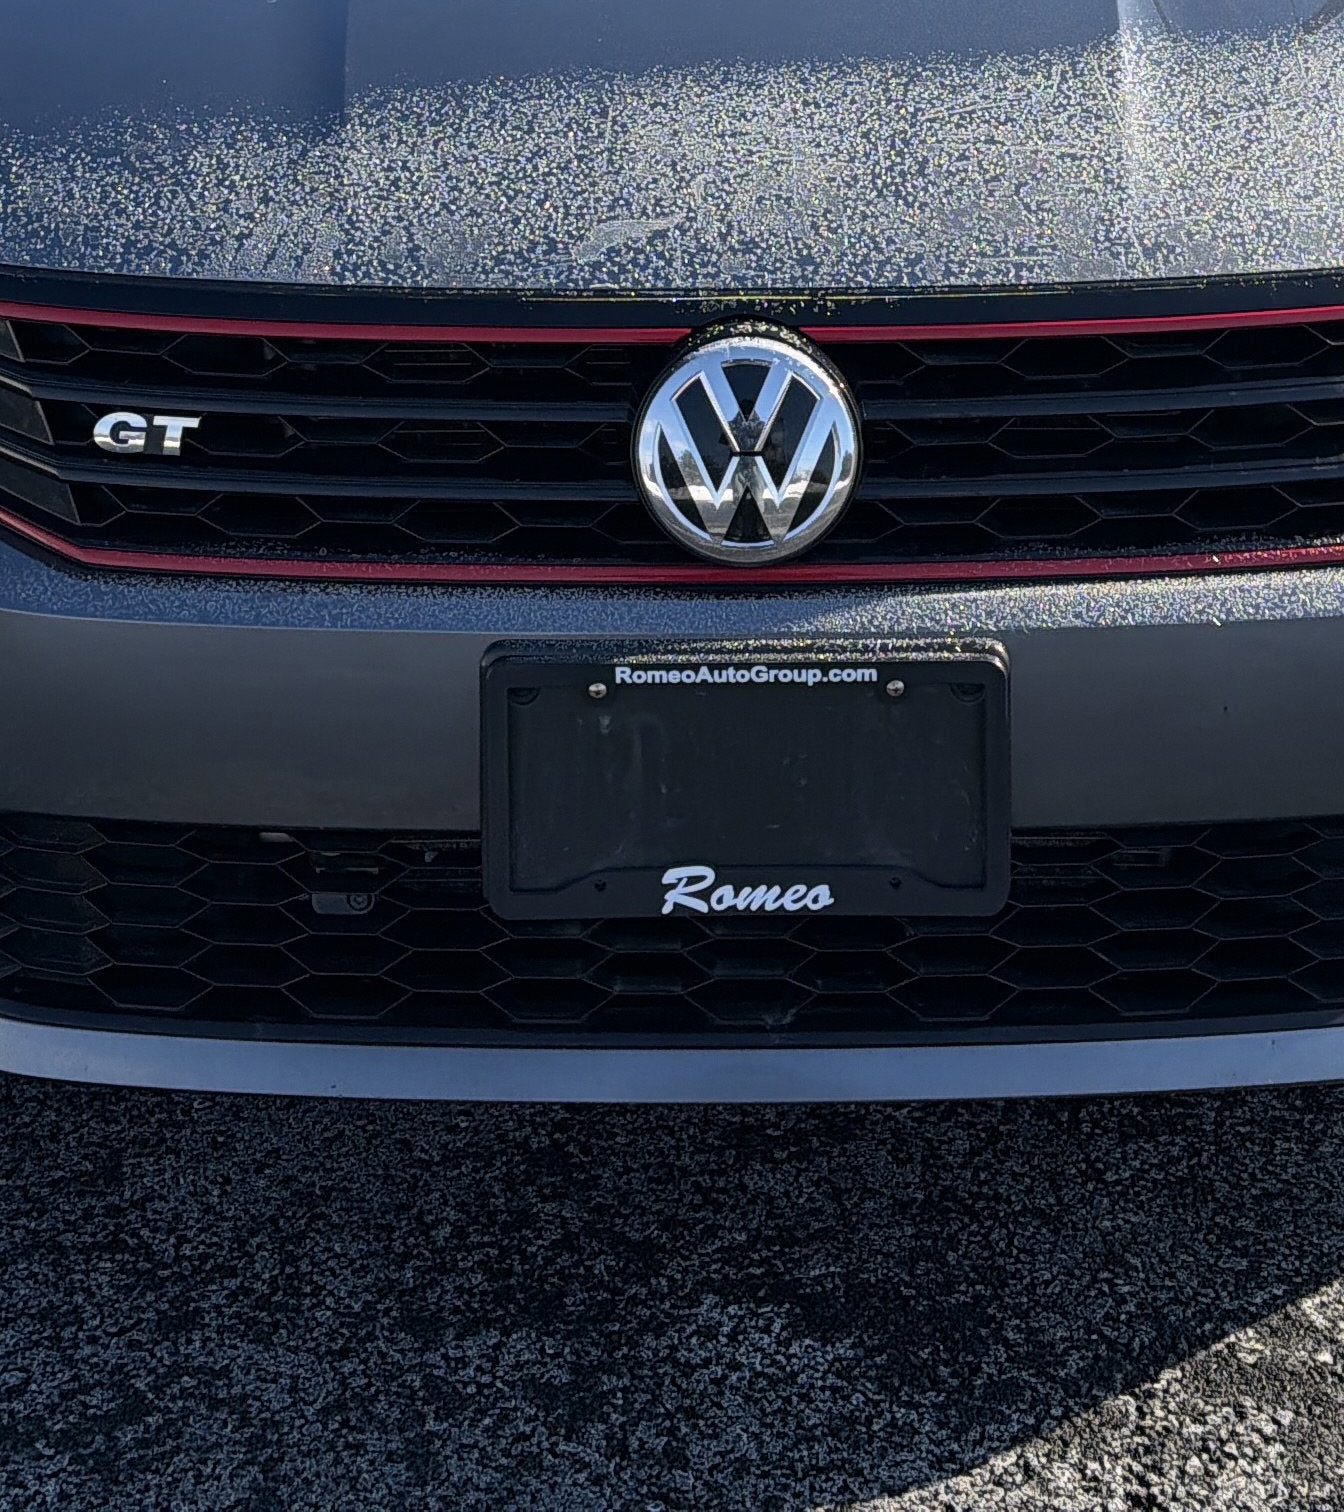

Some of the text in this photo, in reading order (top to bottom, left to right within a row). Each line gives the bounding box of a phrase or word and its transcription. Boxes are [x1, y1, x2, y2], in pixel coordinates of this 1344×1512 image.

[93, 411, 202, 457] GT
[642, 341, 853, 557] VW
[615, 665, 878, 687] RomeoAutoGroup.com
[661, 865, 835, 915] Romeo
